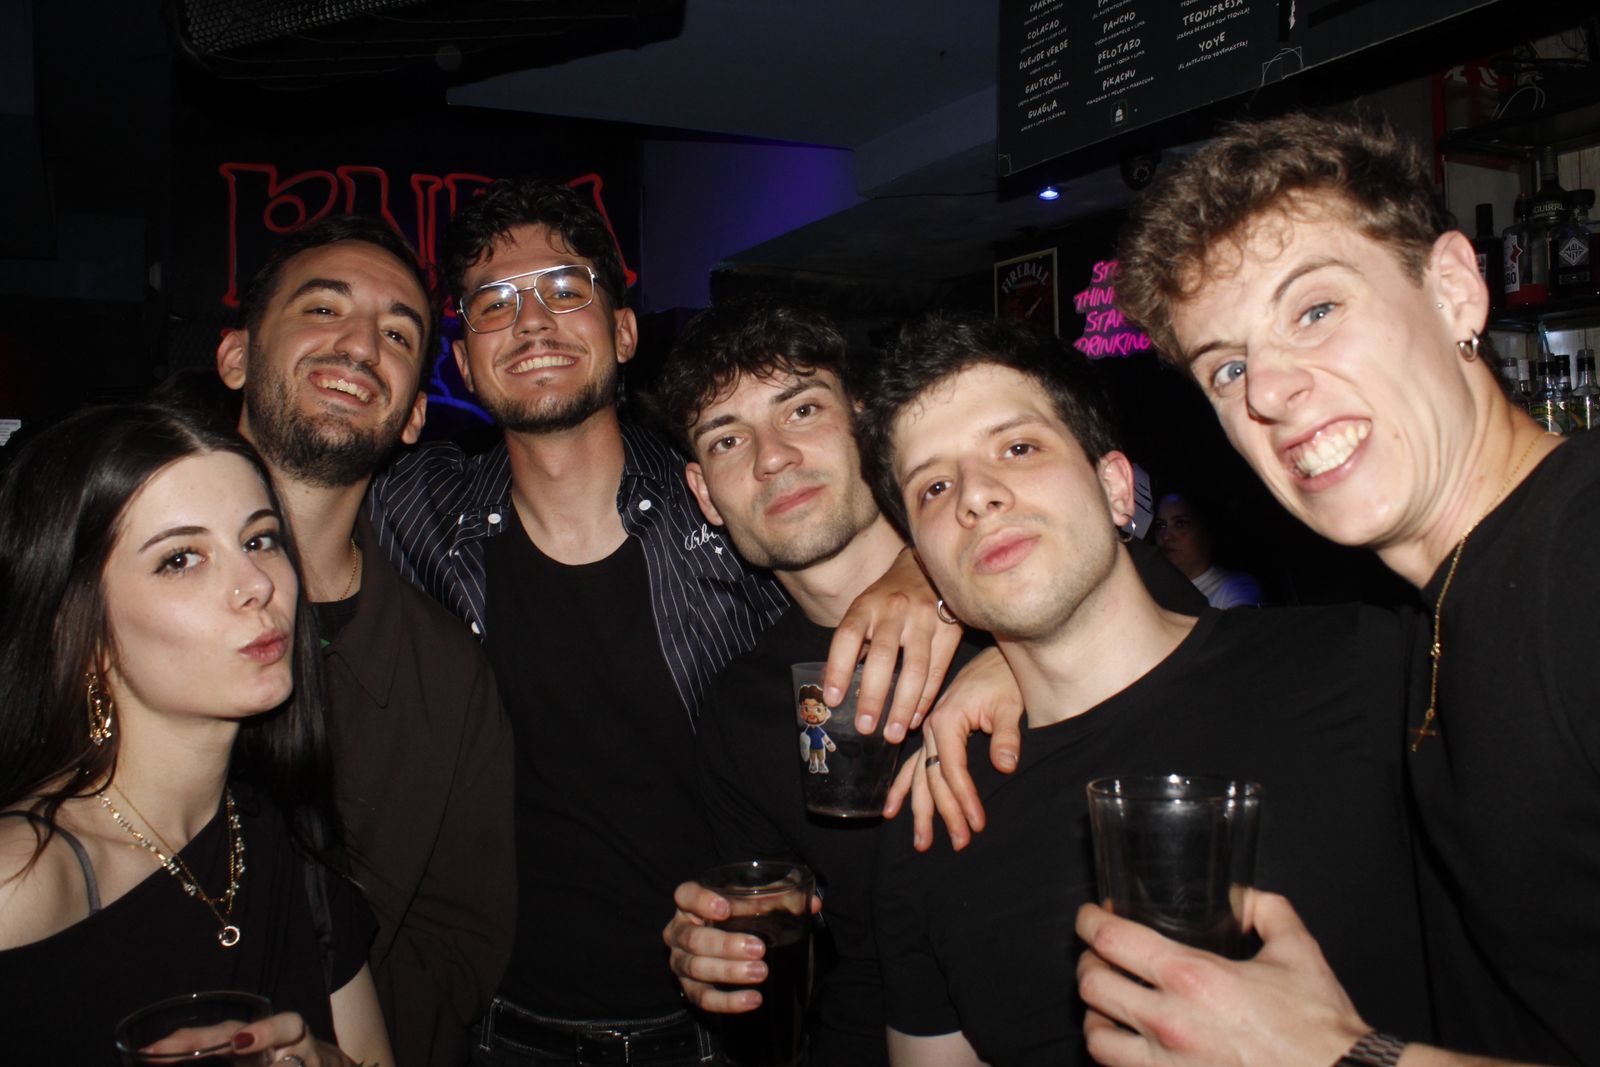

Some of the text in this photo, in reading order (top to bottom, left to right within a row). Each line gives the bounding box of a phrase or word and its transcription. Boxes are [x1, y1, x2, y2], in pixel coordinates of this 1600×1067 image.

[1027, 19, 1060, 40] COLACAO
[1102, 11, 1136, 34] PANCHO
[1097, 38, 1141, 65] PELOTAZO
[1198, 31, 1227, 52] YOYE
[1019, 50, 1045, 70] DUENDE
[1046, 39, 1069, 58] VERDE
[1027, 99, 1058, 119] GUAGUA
[1001, 261, 1049, 295] FIREBALL
[1092, 260, 1121, 284] ST
[1073, 286, 1116, 312] THIN
[1073, 331, 1152, 357] DRINKING
